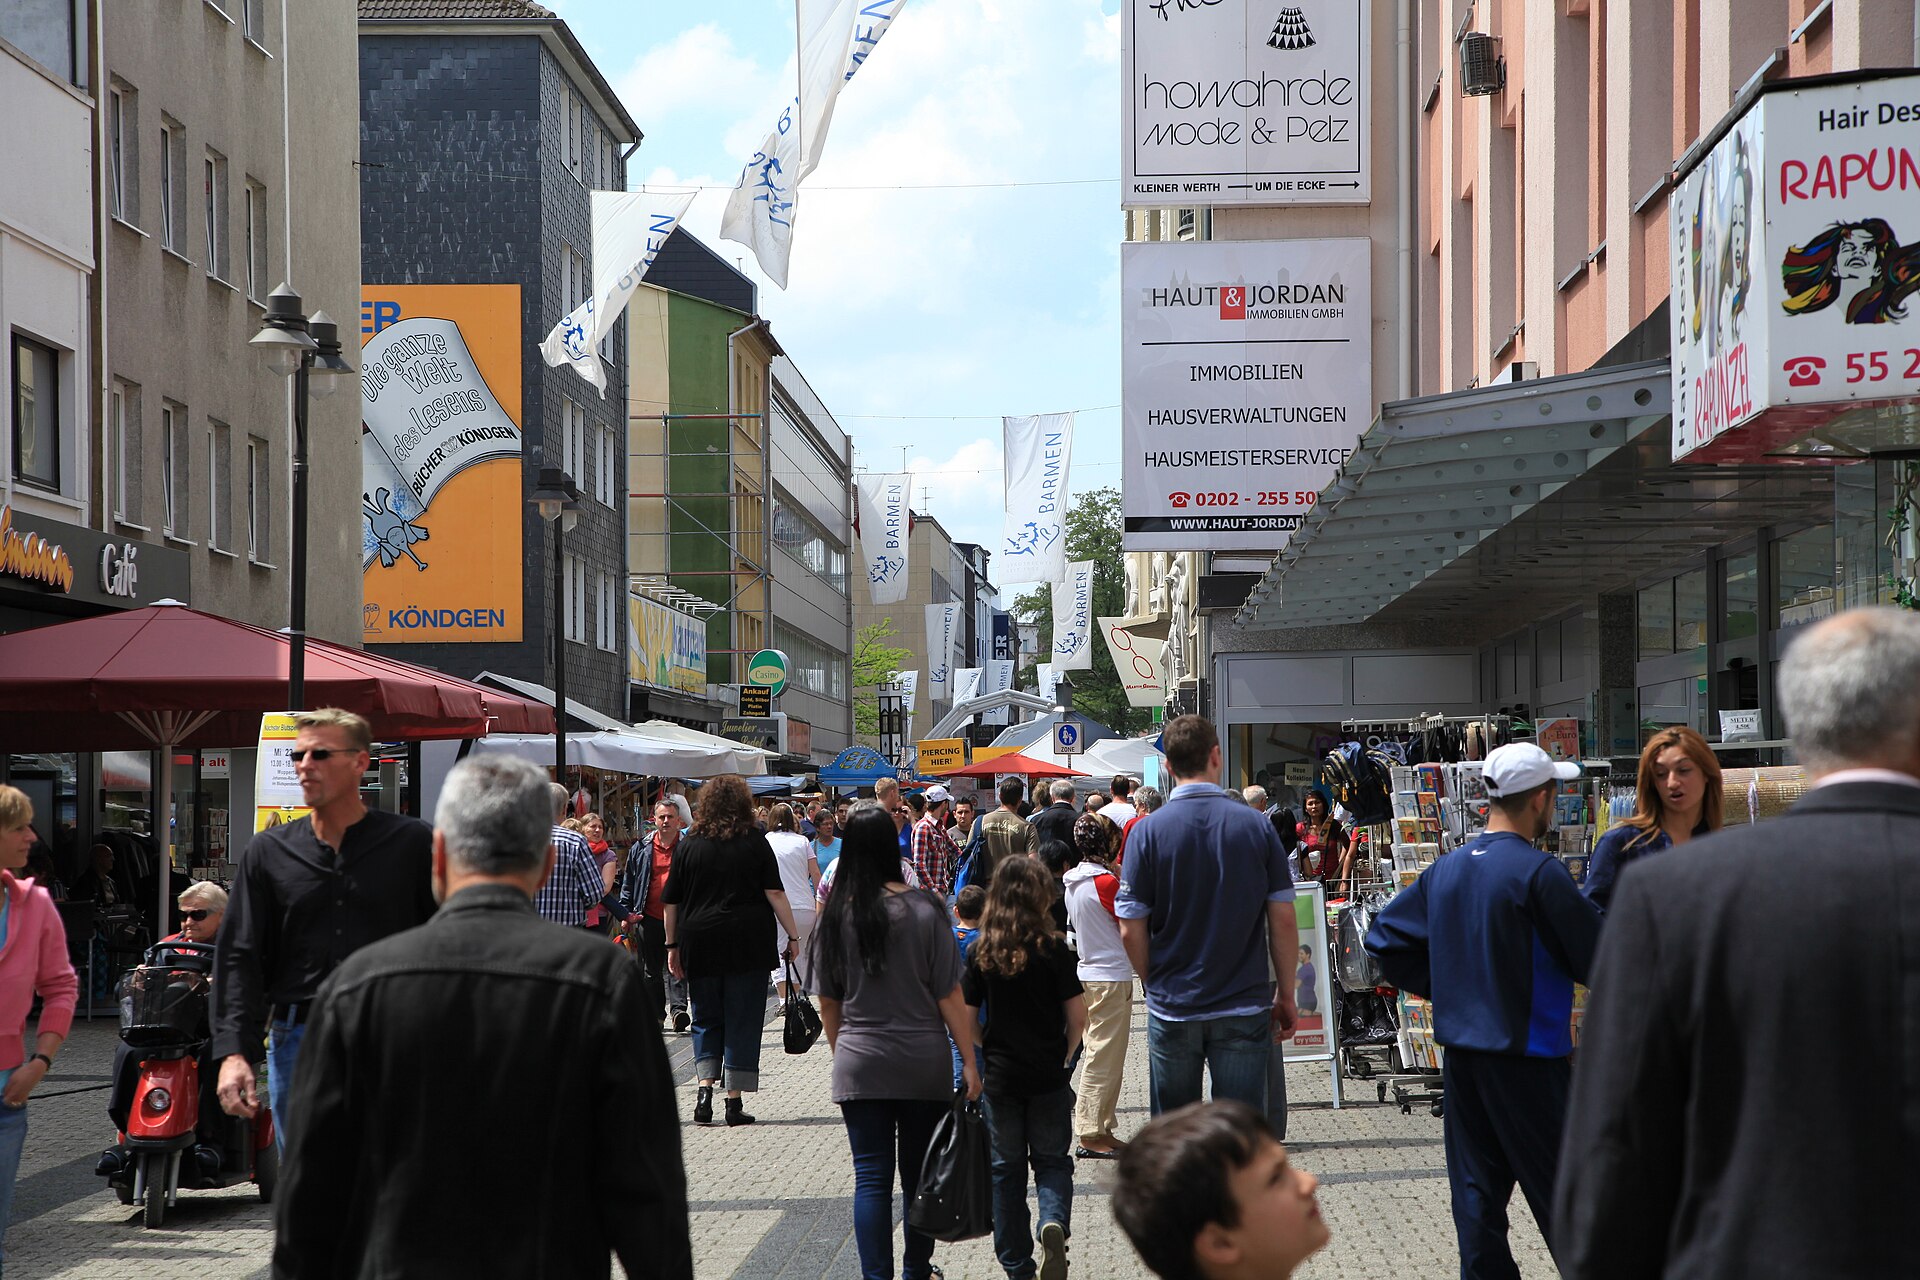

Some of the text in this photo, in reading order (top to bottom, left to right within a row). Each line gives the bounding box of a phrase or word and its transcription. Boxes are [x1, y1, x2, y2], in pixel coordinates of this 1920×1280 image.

[1144, 69, 1353, 109] howahrde
[1142, 115, 1350, 146] Mode & Pelz
[1819, 105, 1870, 132] Hair
[1133, 181, 1326, 193] KLEINER WERTH UM DIE ECKE
[1678, 200, 1686, 345] Design
[1152, 284, 1344, 308] HAUT & JORDAN
[1246, 308, 1344, 319] IMMOBILIEN GMBH
[382, 333, 447, 376] ganze
[1846, 350, 1889, 383] 55
[401, 357, 463, 395] Welt
[1190, 364, 1304, 381] IMMOBILIEN
[1678, 361, 1686, 447] Hair
[1694, 342, 1752, 444] RAPUNZEL
[393, 388, 487, 462] des Lesens
[1148, 406, 1347, 426] HAUSVERWALTUNGEN
[412, 427, 518, 497] BÜCHER KÖNDGEN
[1038, 432, 1063, 514] BARMEN
[1195, 492, 1239, 506] 0202
[1257, 491, 1289, 506] 255
[886, 484, 902, 549] BARMEN
[103, 543, 137, 598] Café
[1076, 571, 1088, 628] BARMEN
[388, 605, 505, 629] KÖNDGEN
[755, 670, 779, 680] Casino
[742, 687, 770, 695] Ankauf
[720, 720, 758, 736] Juwelier
[1556, 730, 1577, 740] Euro
[208, 757, 227, 767] alt
[839, 752, 878, 770] Eis
[921, 747, 960, 757] PIERCING
[931, 758, 953, 766] HIER!
